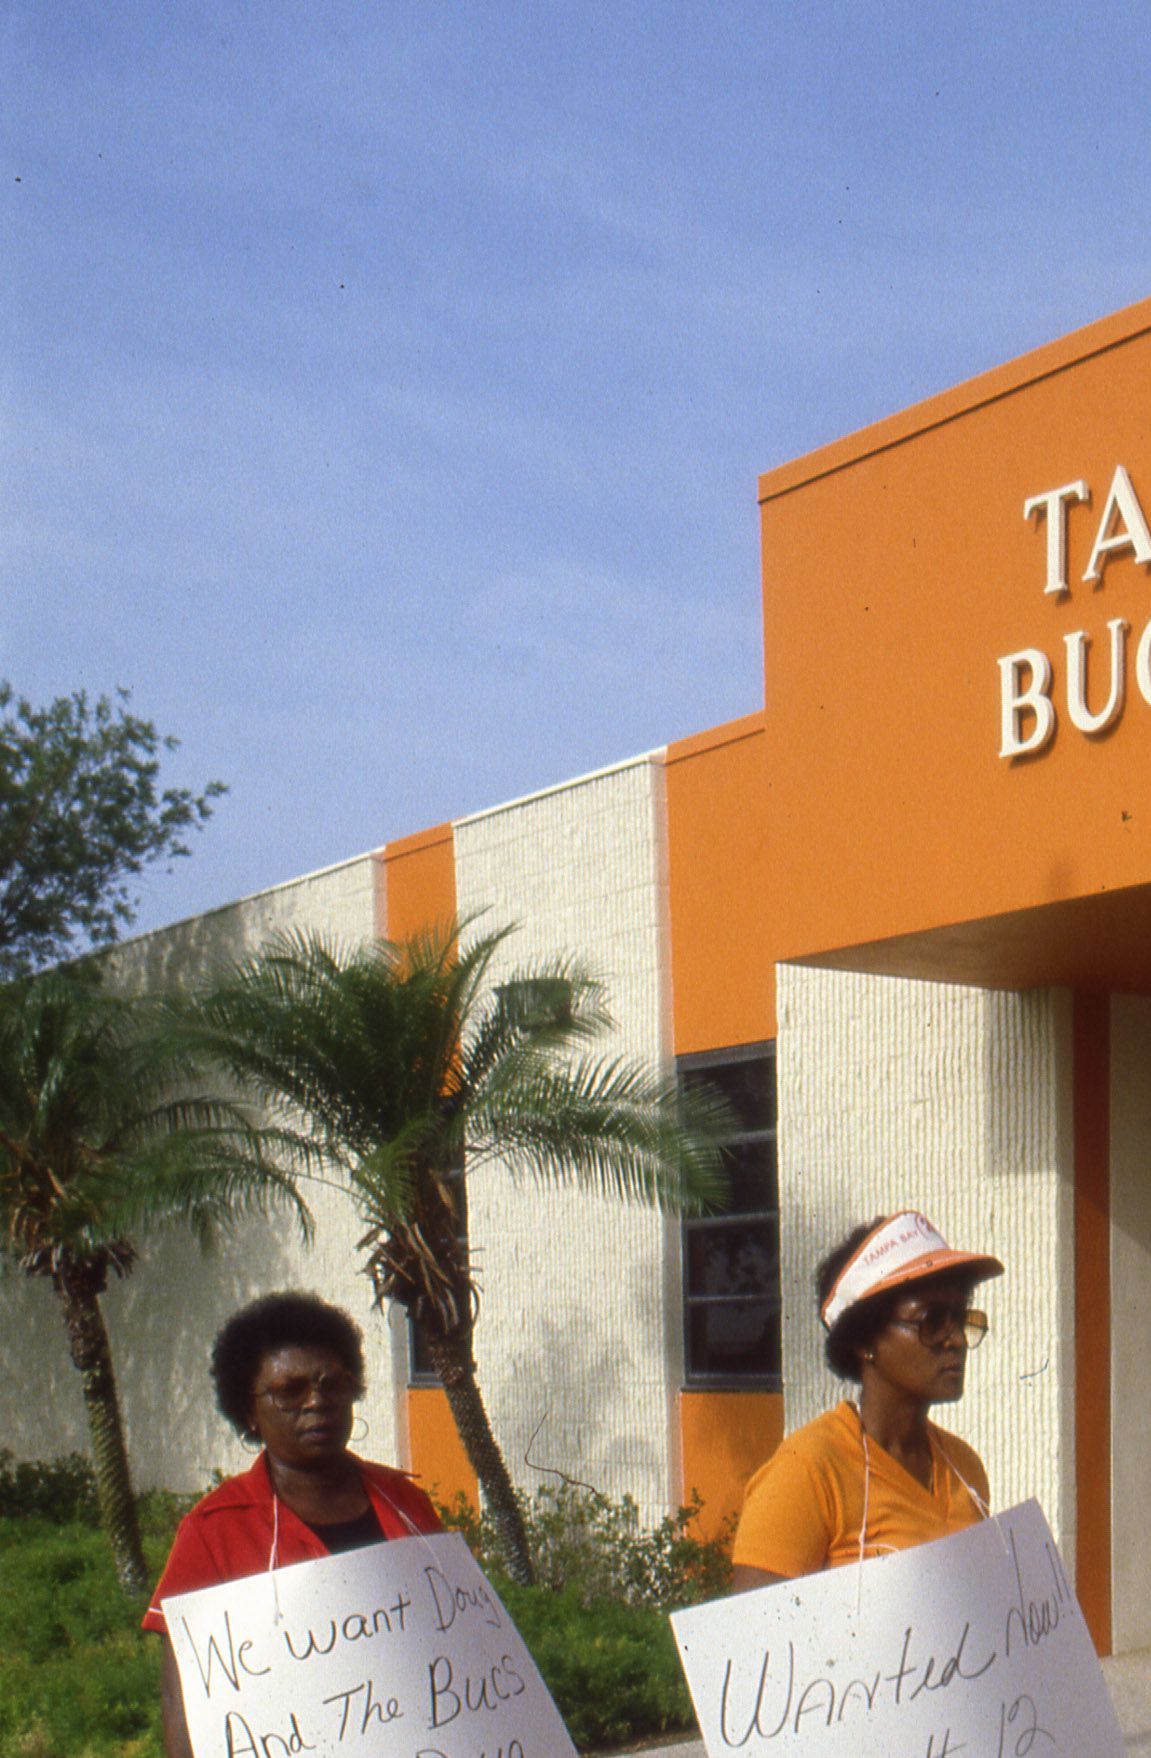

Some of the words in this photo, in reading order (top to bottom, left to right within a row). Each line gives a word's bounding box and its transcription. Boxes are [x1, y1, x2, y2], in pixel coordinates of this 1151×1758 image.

[182, 1610, 271, 1698] We
[322, 1680, 404, 1741] The
[427, 1655, 526, 1730] Bucs
